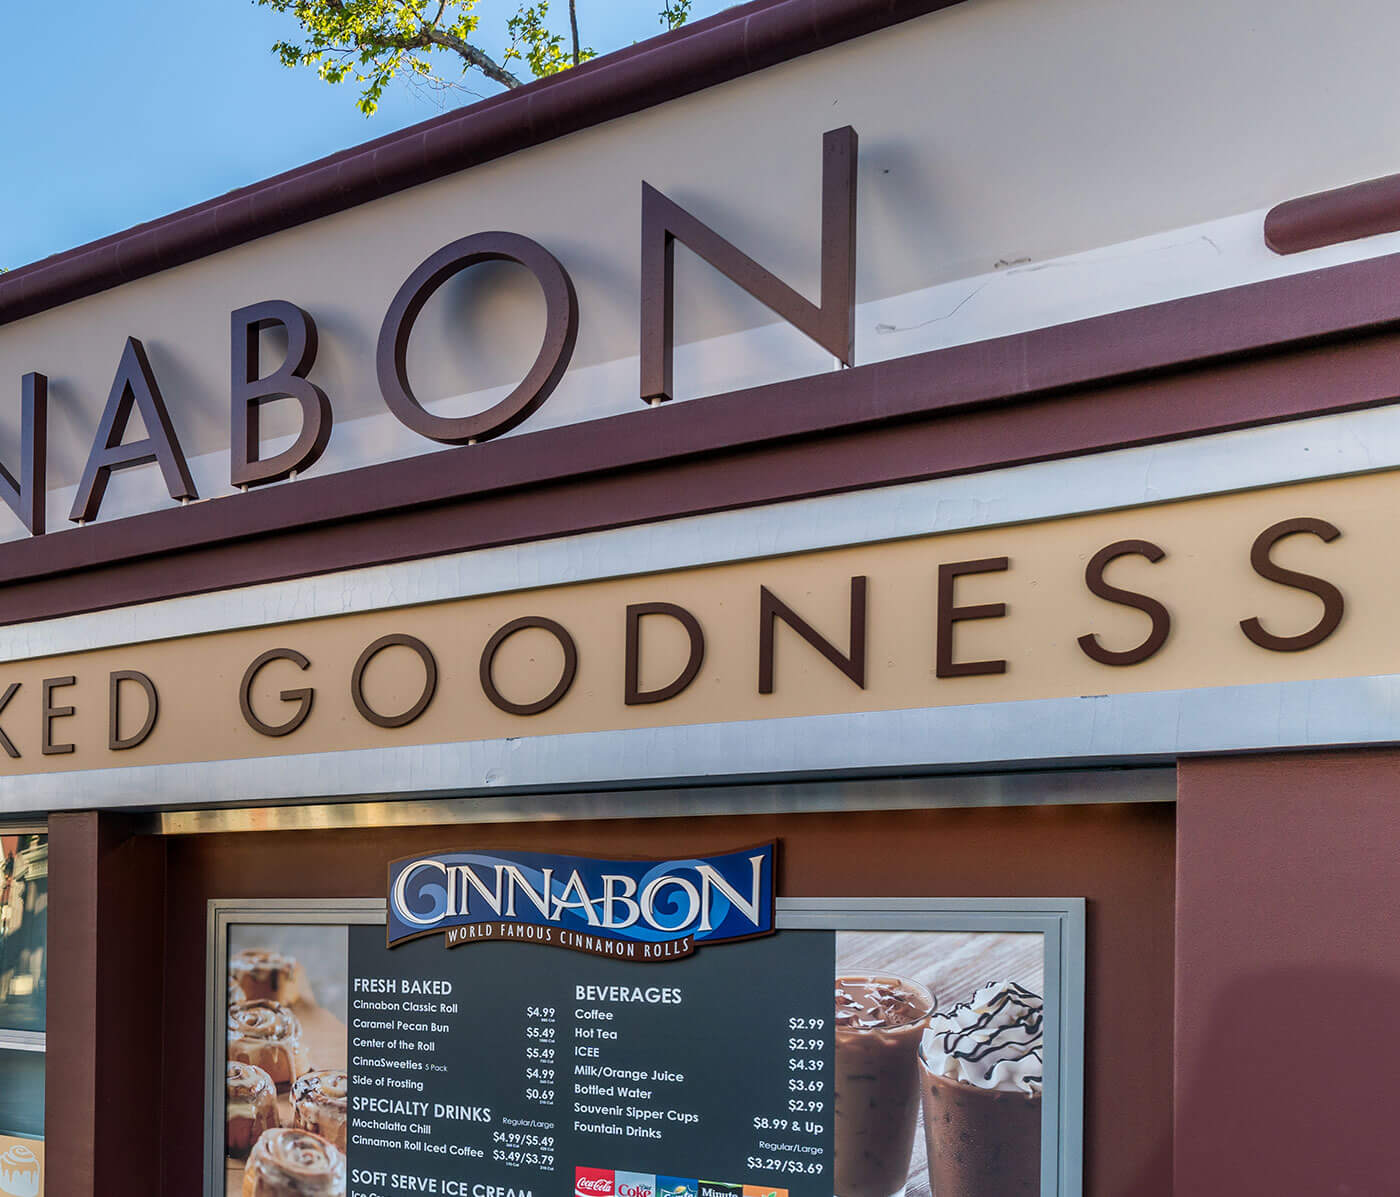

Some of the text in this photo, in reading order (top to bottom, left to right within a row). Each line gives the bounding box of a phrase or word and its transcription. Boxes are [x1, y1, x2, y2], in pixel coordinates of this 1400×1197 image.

[239, 517, 1344, 737] GOODNESS
[394, 854, 765, 932] CINNABON
[448, 924, 688, 957] WORLD FAMOUS CINNAMON ROLLS
[354, 978, 452, 995] FRESH BAKED
[576, 985, 682, 1004] BEVERAGES
[353, 1000, 458, 1013] Cinnabon Classic Roll
[527, 1006, 555, 1018] $4.99
[575, 1009, 613, 1020] Coffee
[353, 1018, 449, 1032] Caramel Pecan Bun
[789, 1017, 824, 1030] $2.99
[526, 1027, 555, 1038] $5.49
[575, 1028, 617, 1039] Hot Tea
[353, 1037, 435, 1051] Center of the Roll
[789, 1038, 824, 1051] $2.99
[526, 1047, 555, 1059] $5.49
[575, 1046, 599, 1057] ICEE
[353, 1056, 447, 1072] CinnaSweeties 5 Pack
[789, 1058, 824, 1071] $4.39
[526, 1068, 555, 1079] $4.99
[574, 1065, 684, 1082] Milk/Orange Juice
[352, 1075, 423, 1092] Side of Frosting
[788, 1079, 824, 1092] $3.69
[526, 1088, 554, 1100] $0.69
[575, 1084, 652, 1099] Bottled Water
[353, 1096, 491, 1123] SPECIALTY DRINKS
[788, 1099, 824, 1112] $2.99
[574, 1102, 699, 1124] Souvenir Sipper Cups
[352, 1118, 431, 1134] Mochalatta Chill
[502, 1117, 554, 1130] Regular/Large
[574, 1121, 662, 1139] Fountain Drinks
[753, 1117, 823, 1135] $8.99 & Up
[352, 1135, 484, 1158] Cinnamon Roll Iced Coffee
[493, 1131, 554, 1148] $4.99/$5.49
[759, 1141, 823, 1155] Regular/Large
[493, 1149, 554, 1167] $3.49/$3.79
[747, 1156, 823, 1174] $3.29/$3.69
[352, 1169, 387, 1186] SOFT
[391, 1174, 437, 1193] SERVE
[442, 1180, 468, 1197] ICE
[618, 1184, 651, 1197] Coke
